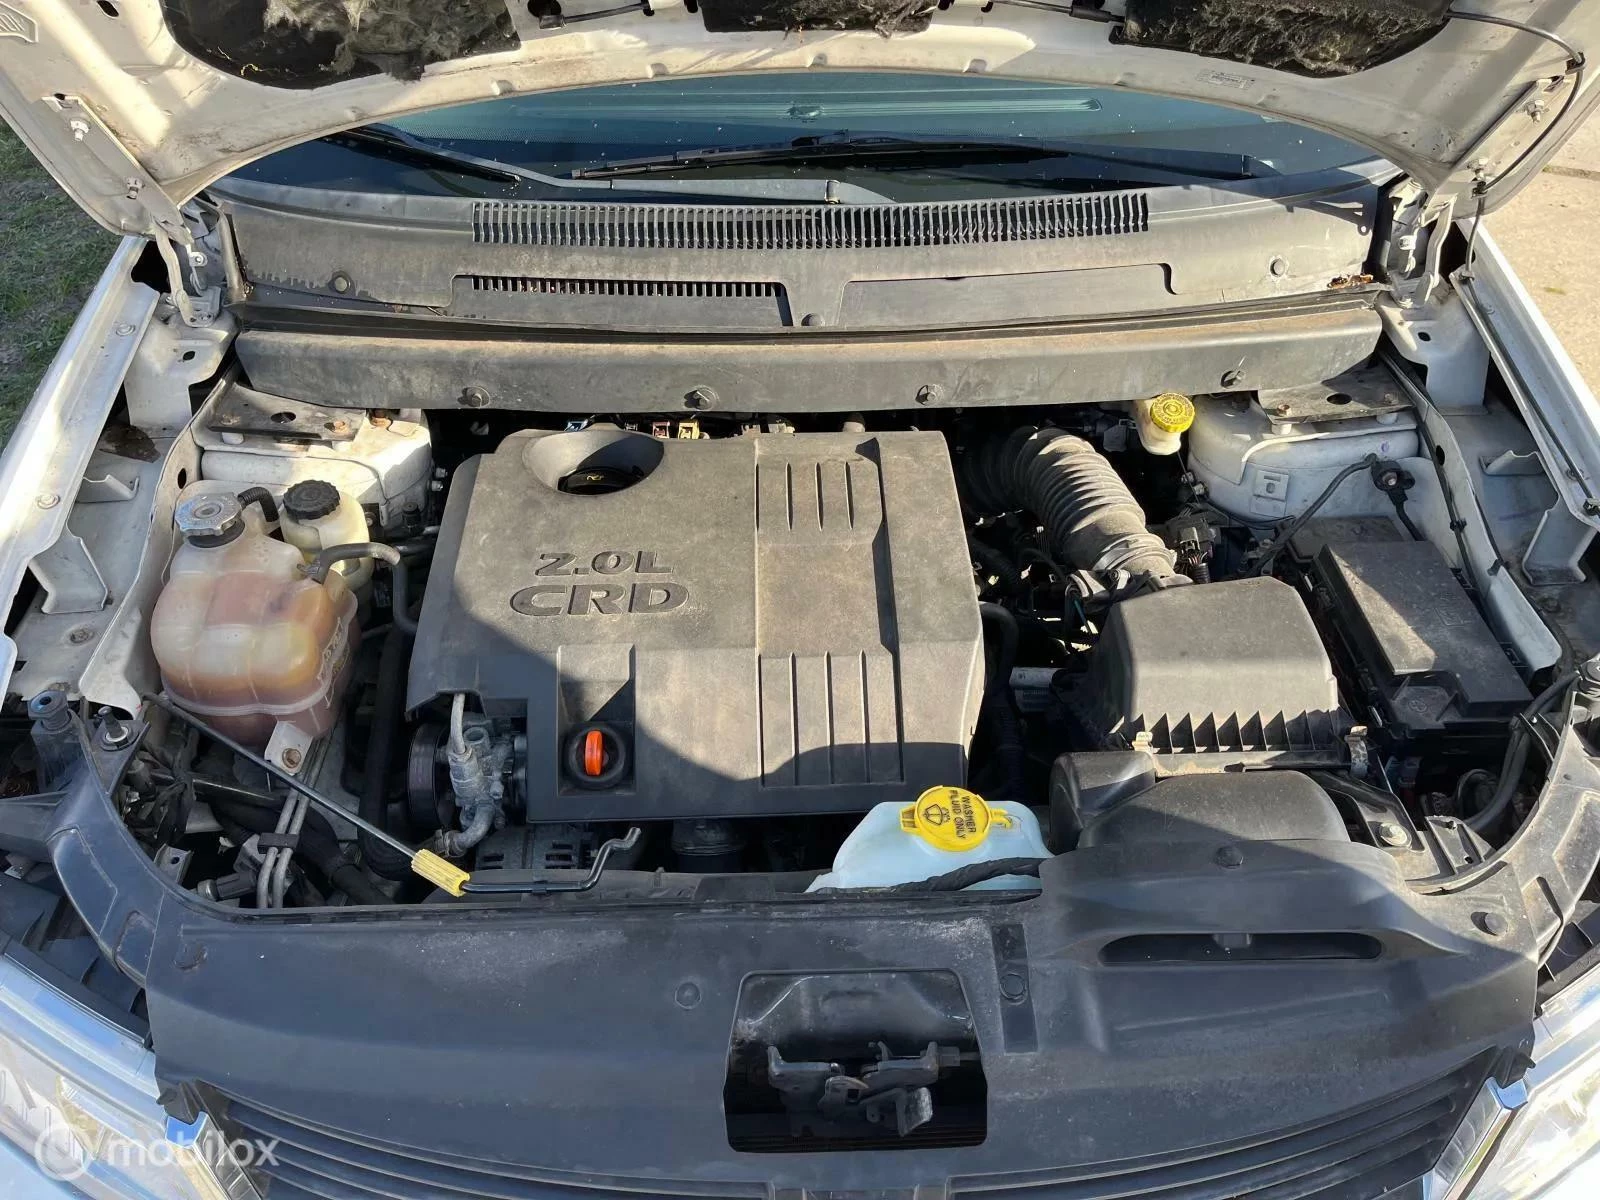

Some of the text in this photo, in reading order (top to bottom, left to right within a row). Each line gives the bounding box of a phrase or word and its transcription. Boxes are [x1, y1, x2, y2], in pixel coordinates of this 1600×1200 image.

[534, 550, 674, 577] 2.0L
[509, 582, 690, 617] CRD
[949, 789, 966, 840] FLUID ONLY
[962, 795, 977, 833] WASHER
